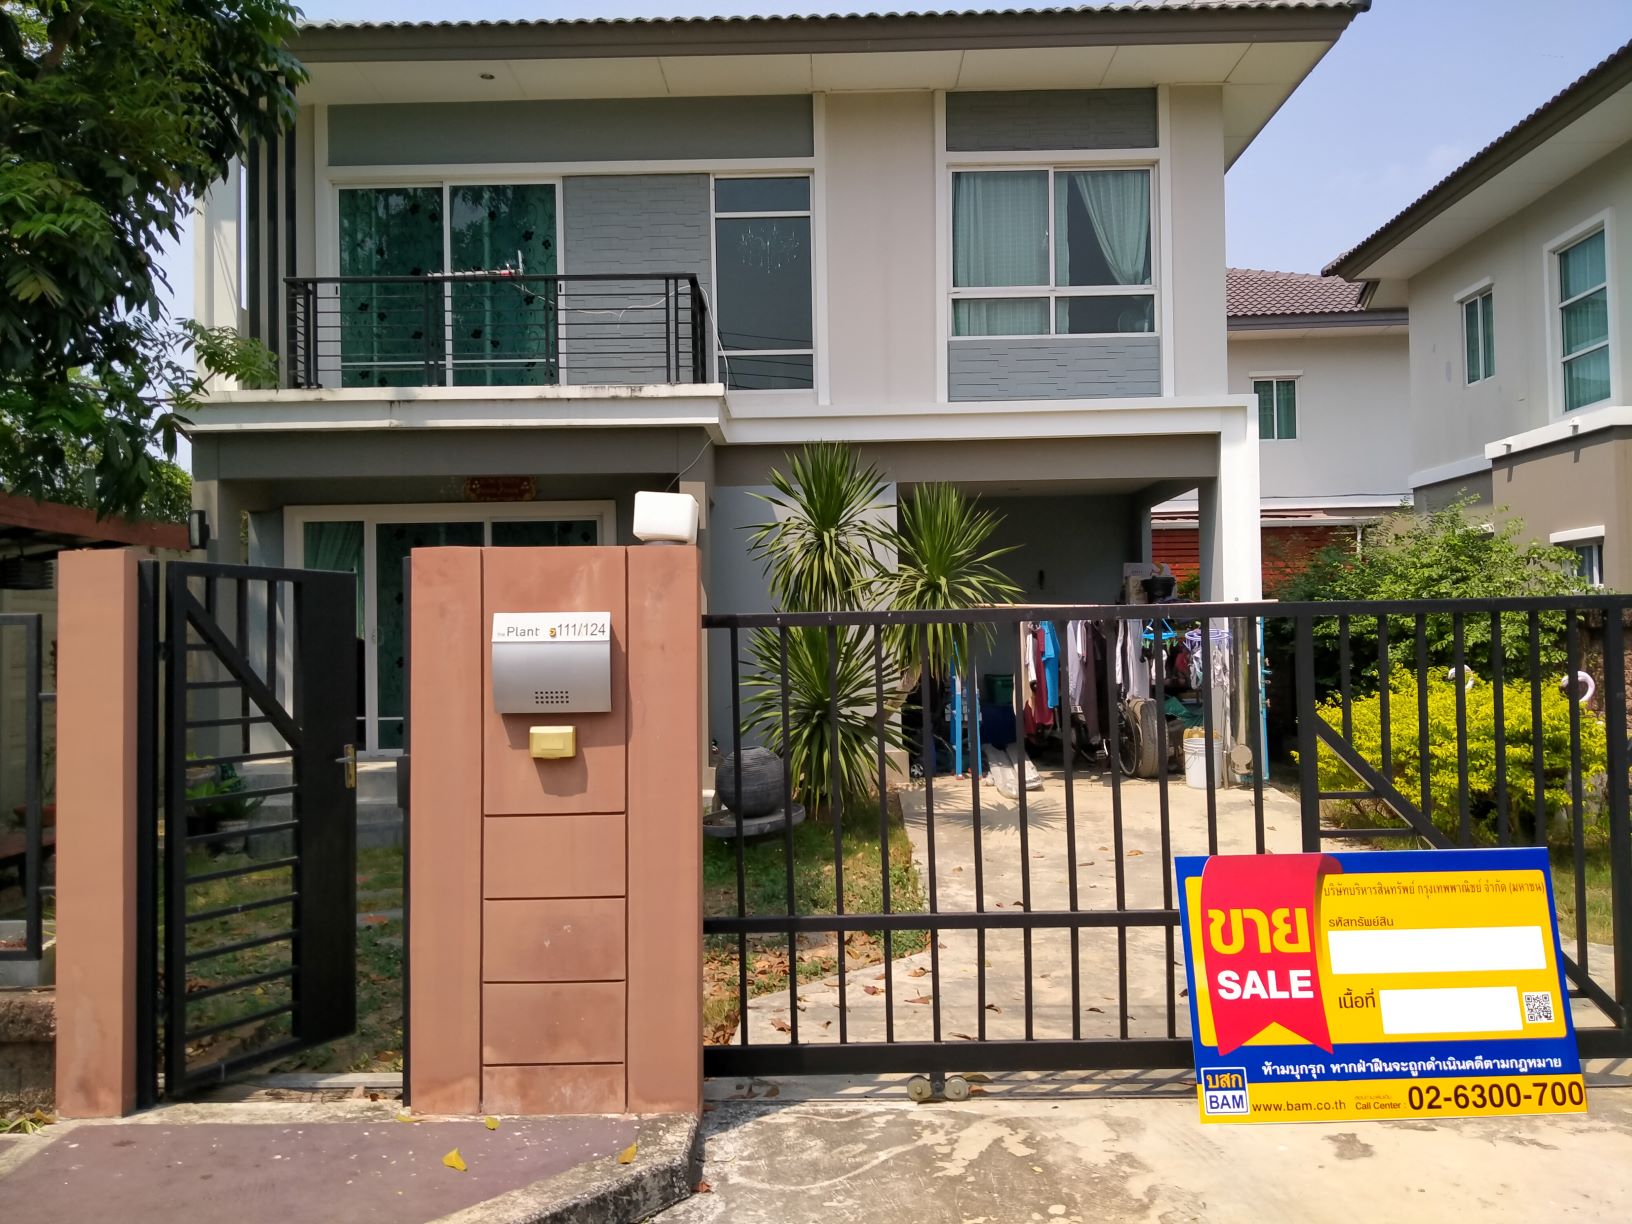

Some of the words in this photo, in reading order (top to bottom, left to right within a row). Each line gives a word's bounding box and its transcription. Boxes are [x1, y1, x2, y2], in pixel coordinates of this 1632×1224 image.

[507, 626, 540, 637] Plant
[558, 623, 606, 636] 111/124
[1323, 881, 1415, 897] บริษัทบริหารสินทรัพย์
[1484, 880, 1507, 893] จำกัด
[1509, 881, 1545, 895] (มหาชน)
[1328, 916, 1394, 928] รหัสทรัพย์สิน
[1207, 907, 1311, 955] ขาย
[1217, 969, 1314, 1001] SALE
[1338, 988, 1376, 1009] เนื้อที่
[1261, 1060, 1326, 1080] ห้ามบุกรุก
[1206, 1073, 1243, 1089] บสก
[1209, 1095, 1245, 1110] BAM
[1355, 1102, 1371, 1110] Call
[1373, 1102, 1401, 1110] Center
[1408, 1081, 1584, 1110] 02-6300-700
[1252, 1100, 1346, 1112] www.bam.co.th
